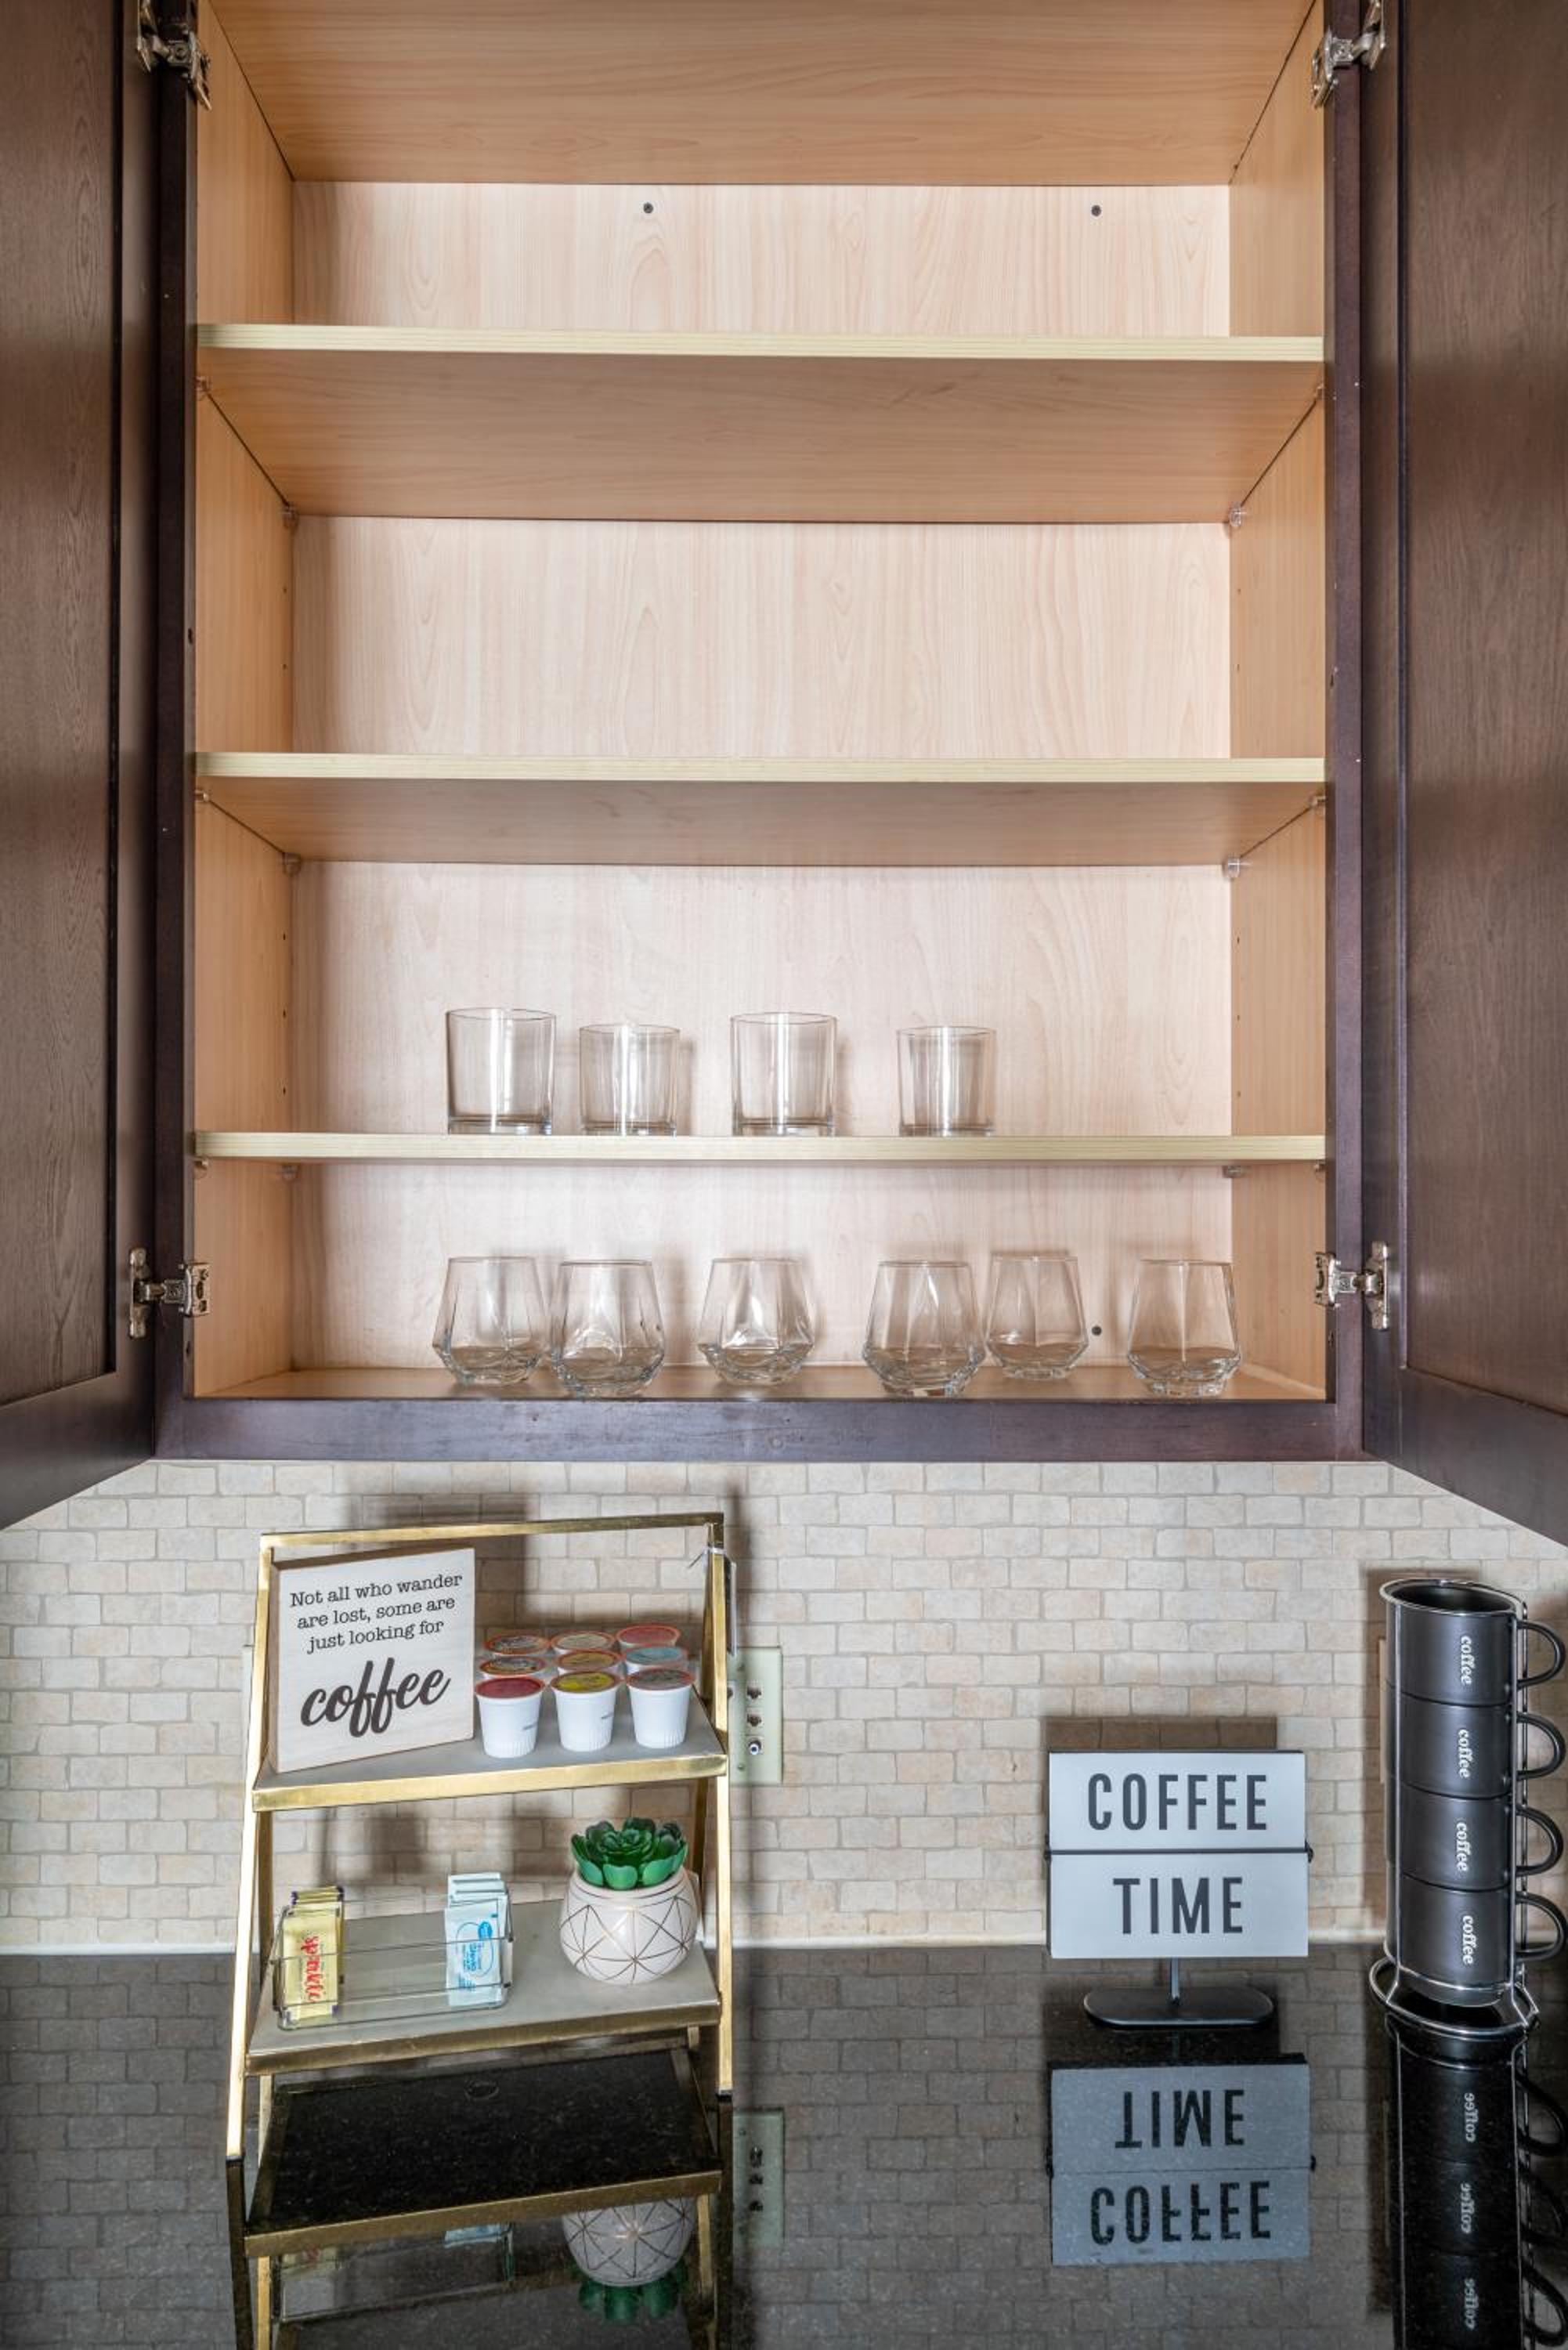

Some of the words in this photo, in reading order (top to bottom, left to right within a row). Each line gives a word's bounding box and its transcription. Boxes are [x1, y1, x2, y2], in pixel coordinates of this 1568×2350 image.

[290, 1590, 323, 1607] Not
[327, 1586, 350, 1603] all
[355, 1582, 392, 1600] who
[396, 1574, 463, 1593] wander
[297, 1614, 328, 1629] are
[333, 1610, 371, 1625] lost,
[375, 1602, 422, 1619] some
[426, 1597, 456, 1612] are
[306, 1634, 345, 1655] just
[349, 1623, 415, 1645] looking
[419, 1620, 445, 1635] for
[1460, 1635, 1475, 1686] coffee
[301, 1657, 452, 1738] coffee
[1457, 1729, 1472, 1780] coffee
[1087, 1773, 1267, 1831] COFFEE
[1455, 1822, 1472, 1873] coffee
[1112, 1877, 1244, 1935] TIME
[1461, 1914, 1476, 1965] coffee
